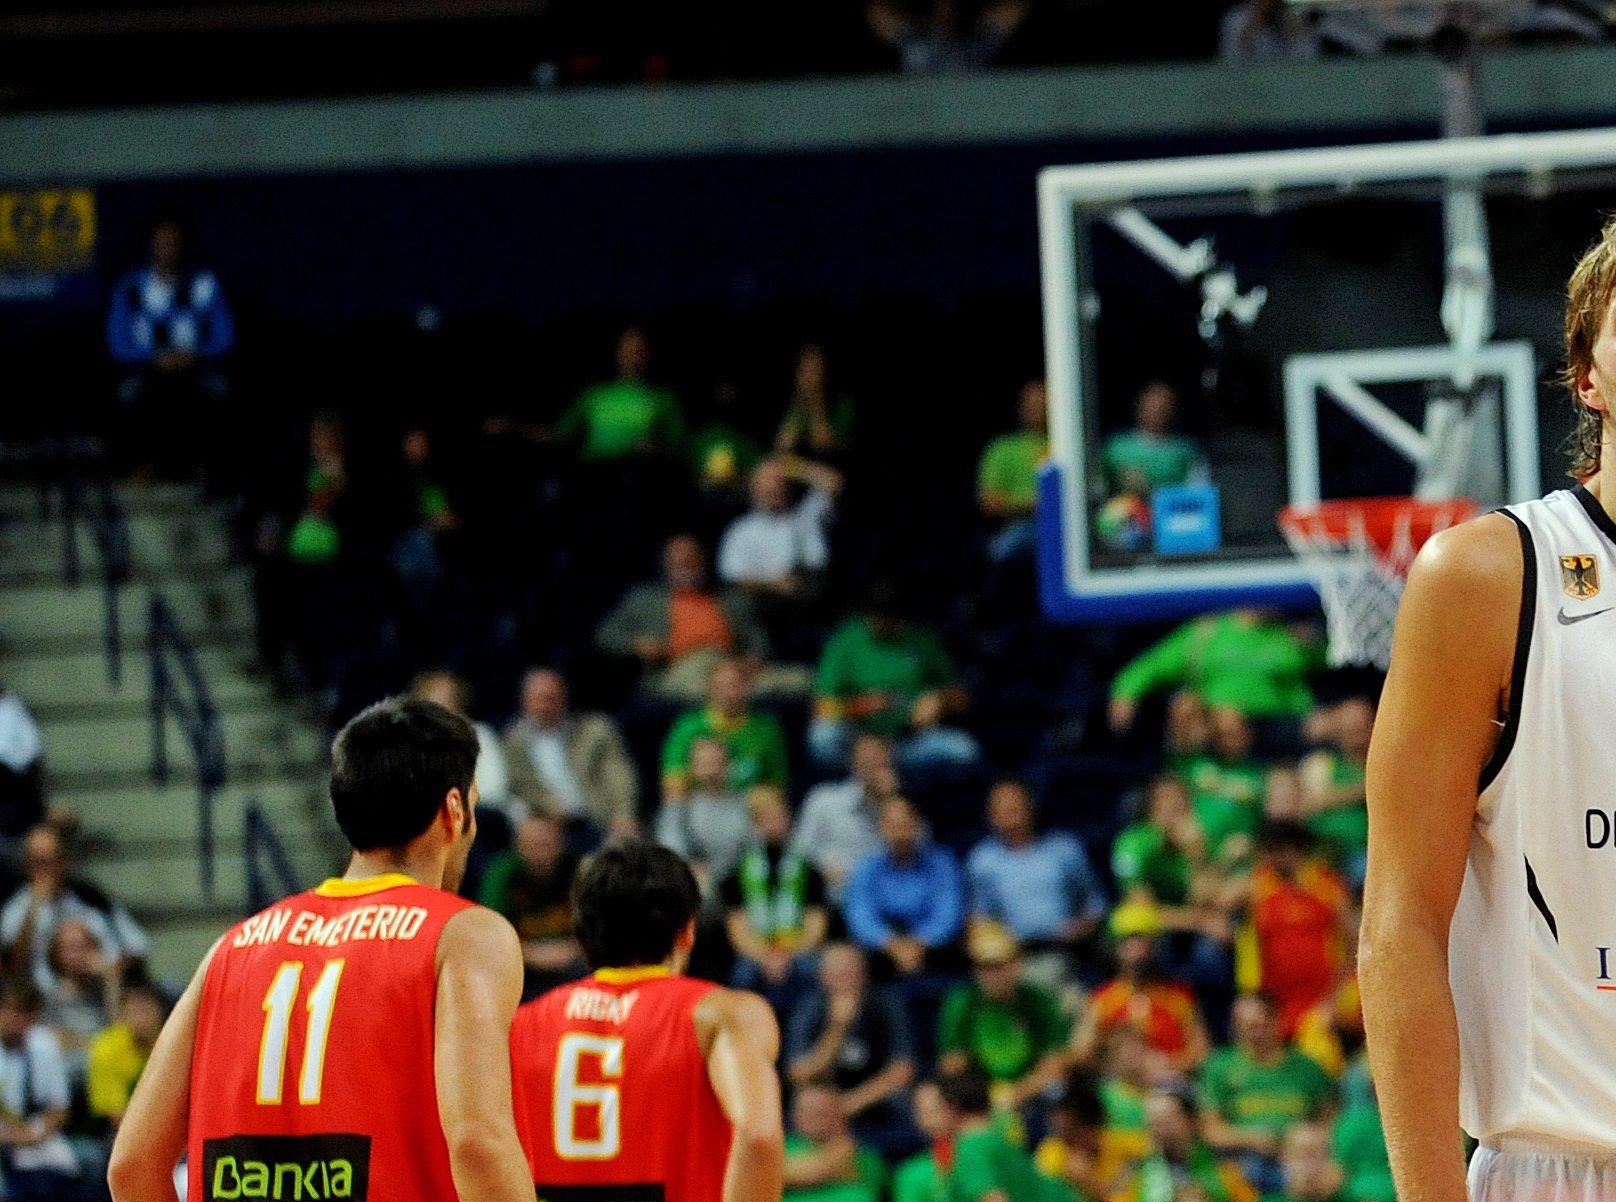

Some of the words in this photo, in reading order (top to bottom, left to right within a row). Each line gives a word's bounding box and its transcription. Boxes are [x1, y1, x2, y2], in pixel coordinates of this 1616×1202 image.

[232, 908, 292, 948] SAN
[287, 904, 428, 948] EMETERIO
[256, 958, 346, 1105] 11
[553, 1030, 625, 1161] 6
[213, 1156, 352, 1201] Bankia
